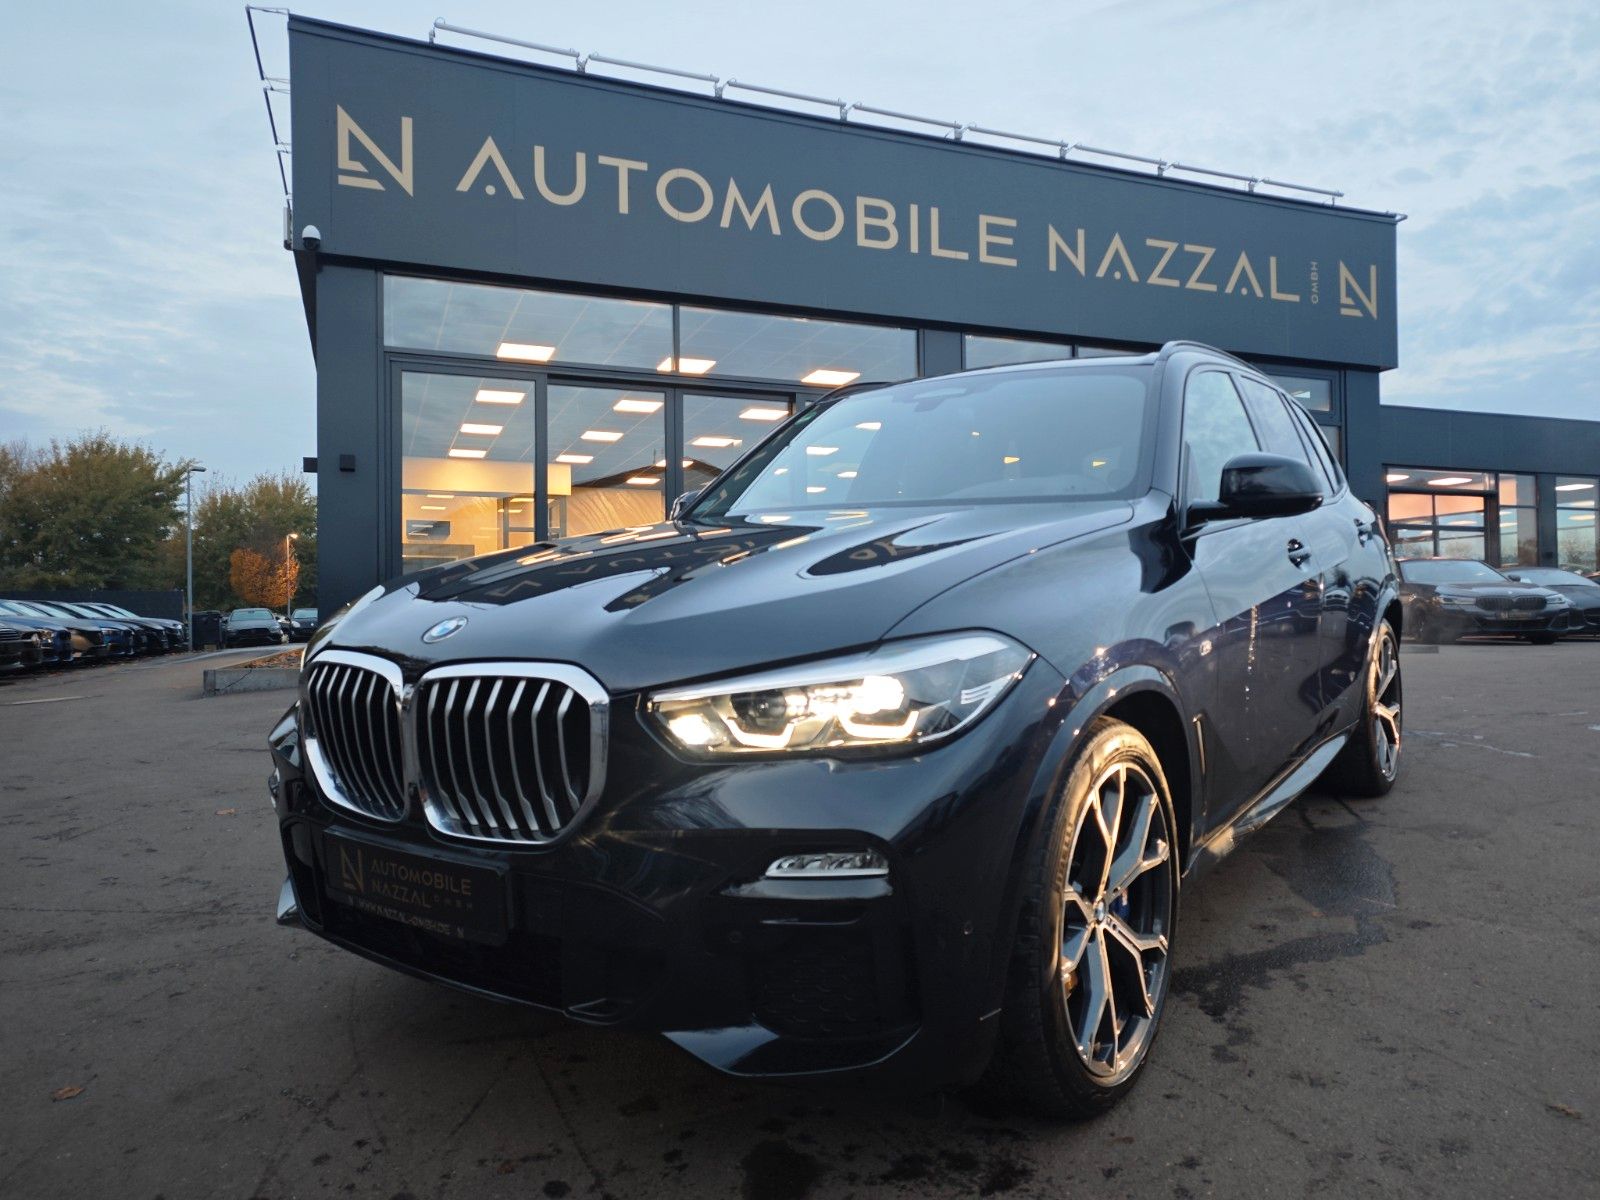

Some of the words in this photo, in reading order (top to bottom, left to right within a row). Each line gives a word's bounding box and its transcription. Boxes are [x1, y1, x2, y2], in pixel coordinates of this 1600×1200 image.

[455, 135, 1017, 268] AUTOMOBILE
[1047, 222, 1300, 302] NAZZAL
[369, 858, 473, 896] AUTOMOBILE
[371, 879, 432, 909] NAZZAL
